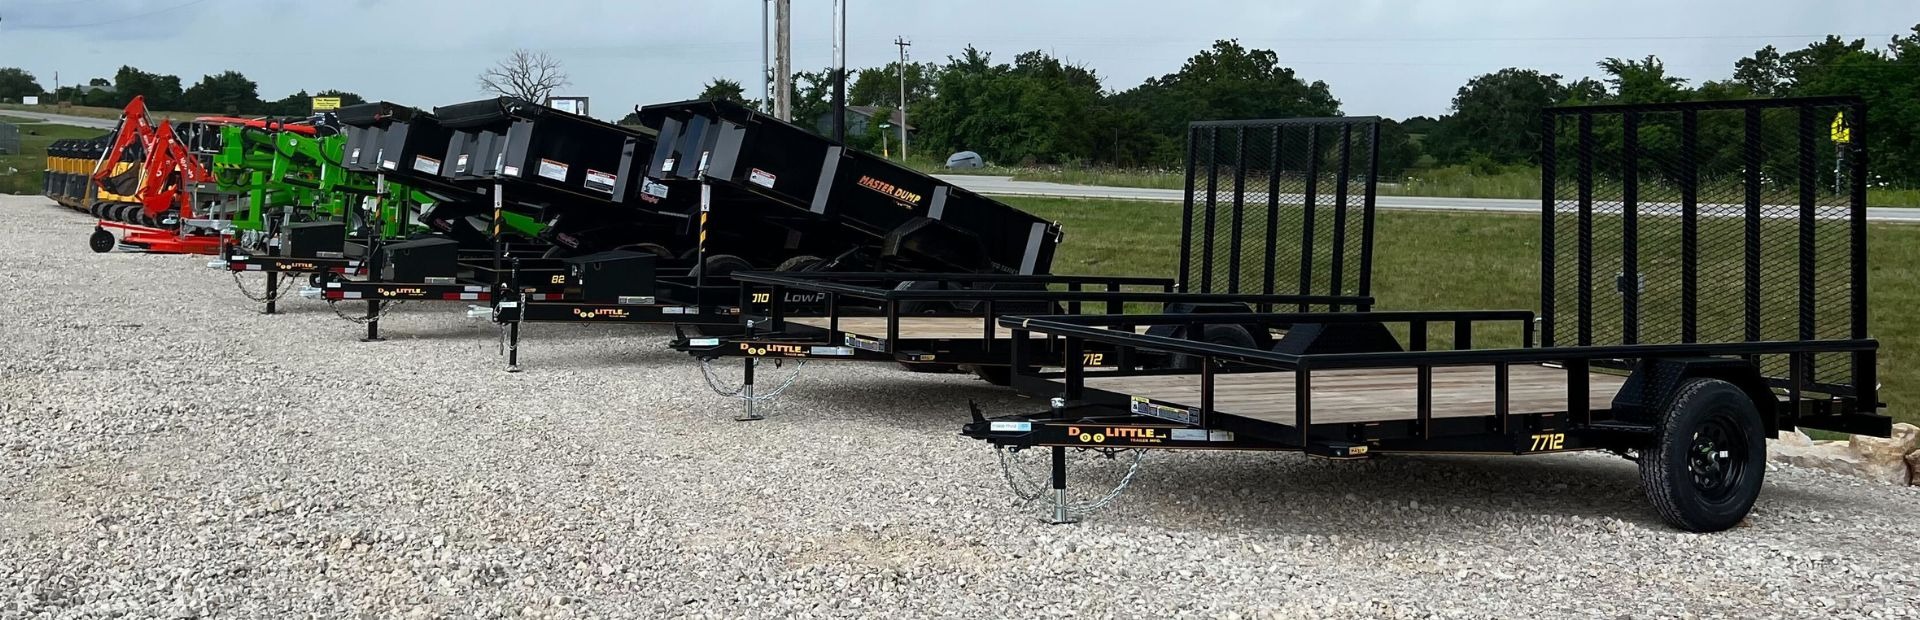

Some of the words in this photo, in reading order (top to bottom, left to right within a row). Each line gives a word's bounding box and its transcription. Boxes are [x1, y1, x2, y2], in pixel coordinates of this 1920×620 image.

[858, 175, 895, 195] MASTER
[894, 187, 922, 203] DUMP
[551, 275, 565, 284] 82
[740, 342, 802, 356] DOOLITTLE
[1083, 353, 1103, 365] 712
[1068, 426, 1155, 443] DOOLITTLE
[1531, 433, 1565, 451] 7712
